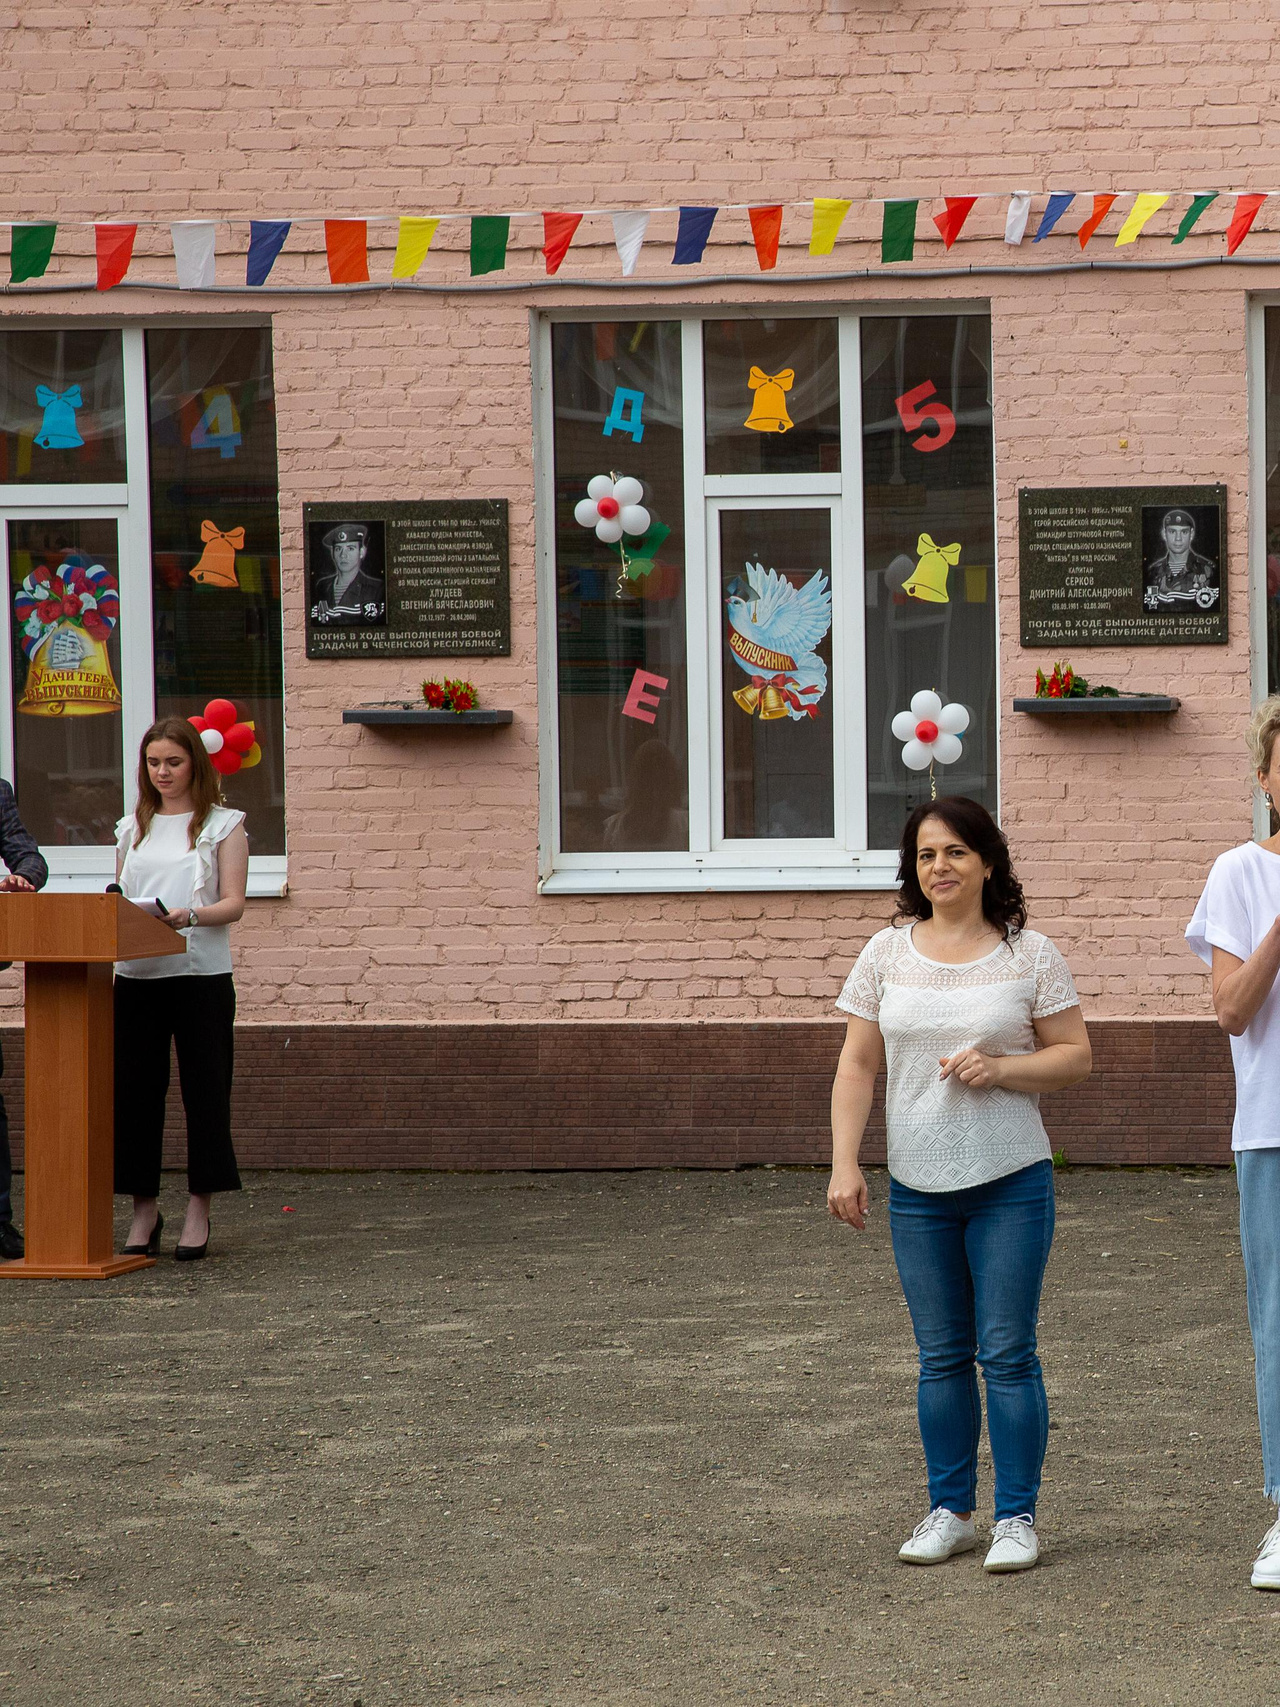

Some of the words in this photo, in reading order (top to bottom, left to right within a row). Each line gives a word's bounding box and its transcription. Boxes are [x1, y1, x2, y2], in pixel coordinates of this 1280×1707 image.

[602, 385, 645, 443] Д
[894, 379, 956, 452] 5
[190, 394, 242, 458] 4
[1033, 506, 1048, 515] ЭТОЙ
[1049, 507, 1068, 515] ШКОЛЕ
[1111, 506, 1132, 514] УЧИЛСЯ
[397, 518, 411, 527] ЭТОЙ
[412, 519, 431, 527] ШКОЛЕ
[479, 517, 500, 526] УЧИЛСЯ
[1034, 518, 1051, 527] ГЕРОЙ
[1053, 517, 1089, 527] РОССИЙСКОЙ
[406, 531, 430, 539] КАВАЛЕР
[431, 531, 453, 540] ОРДЕНА
[1036, 531, 1067, 540] КОМАНДИР
[1068, 529, 1102, 538] ШТУРМОВОЙ
[1103, 530, 1125, 539] ГРУППЫ
[399, 543, 436, 551] ЗАМЕСТИТЕЛЬ
[437, 542, 470, 550] КОМАНДИРА
[472, 542, 494, 550] ВЗВОДА
[1029, 543, 1050, 552] ОТРЯДА
[1051, 542, 1095, 551] СПЕЦИАЛЬНОГО
[1096, 542, 1132, 550] НАЗНАЧЕНИЯ
[398, 553, 447, 563] МОТОСТРЕЛКОВОЙ
[447, 554, 463, 562] РОТЫ
[467, 554, 500, 562] БАТАЛЬОНА
[1081, 554, 1092, 562] МВД
[403, 566, 421, 575] ПОЛКА
[422, 566, 464, 574] ОПЕРАТИВНОГО
[465, 565, 500, 573] НАЗНАЧЕНИЯ
[1068, 566, 1094, 575] КАПИТАН
[406, 578, 419, 587] МВД
[444, 576, 470, 587] СТАРШИЙ
[470, 577, 496, 586] СЕРЖАНТ
[1065, 576, 1095, 587] СЕРКОВ
[429, 588, 463, 599] ХЛУДЕЕВ
[1029, 588, 1066, 601] ДМИТРИЙ
[1067, 587, 1133, 600] АЛЕКСАНДРОВИЧ
[400, 598, 434, 610] ЕВГЕНИЙ
[435, 599, 495, 610] ВЯЧЕСЛАВОВИЧ
[1028, 620, 1062, 629] ПОГИБ
[1065, 620, 1071, 628] В
[1075, 619, 1102, 629] ХОДЕ
[1105, 618, 1175, 628] ВЫПОЛНЕНИЯ
[1178, 616, 1220, 626] БОЕВОЙ
[313, 632, 346, 641] ПОГИБ
[350, 632, 356, 640] В
[359, 631, 386, 641] ХОДЕ
[389, 630, 458, 640] ВЫПОЛНЕНИЯ
[461, 628, 501, 639] БОЕВОЙ
[1037, 629, 1078, 639] ЗАДАЧИ
[1082, 629, 1088, 637] В
[1091, 628, 1156, 637] РЕСПУБЛИКЕ
[1159, 627, 1211, 637] ДАГЕСТАН
[318, 641, 359, 651] ЗАДАЧИ
[362, 641, 368, 649] В
[372, 638, 430, 649] ЧЕЧЕНСКОЙ
[433, 639, 497, 648] РЕСПУБЛИКЕ
[729, 632, 793, 671] ВЫПУСКНИК
[25, 684, 116, 700] ВЫПУСКНИК!
[621, 668, 669, 724] Е
